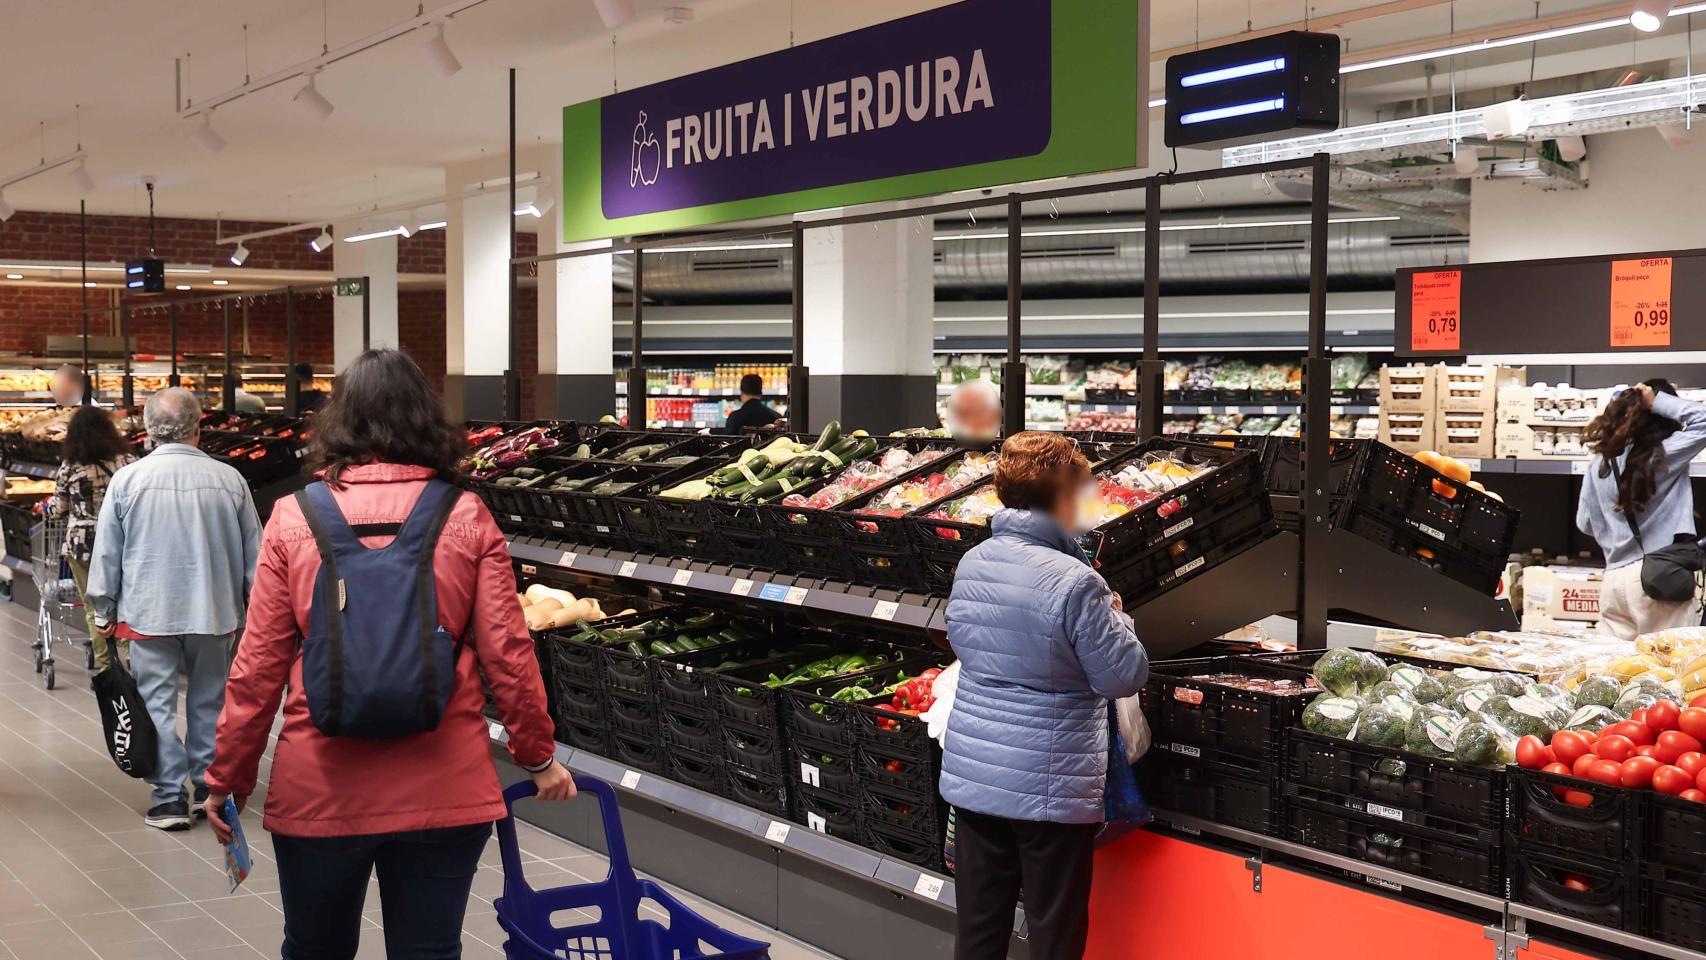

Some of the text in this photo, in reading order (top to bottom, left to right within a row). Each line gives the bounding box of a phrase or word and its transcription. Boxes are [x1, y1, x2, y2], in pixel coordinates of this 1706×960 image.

[666, 48, 995, 169] FRUITA I VERDURA
[1640, 259, 1669, 267] OFERTA
[1634, 310, 1668, 329] 0,99
[1428, 317, 1457, 335] 0,79
[1562, 588, 1579, 599] 24
[1567, 600, 1600, 612] MEDIA
[1382, 807, 1396, 815] IFCO
